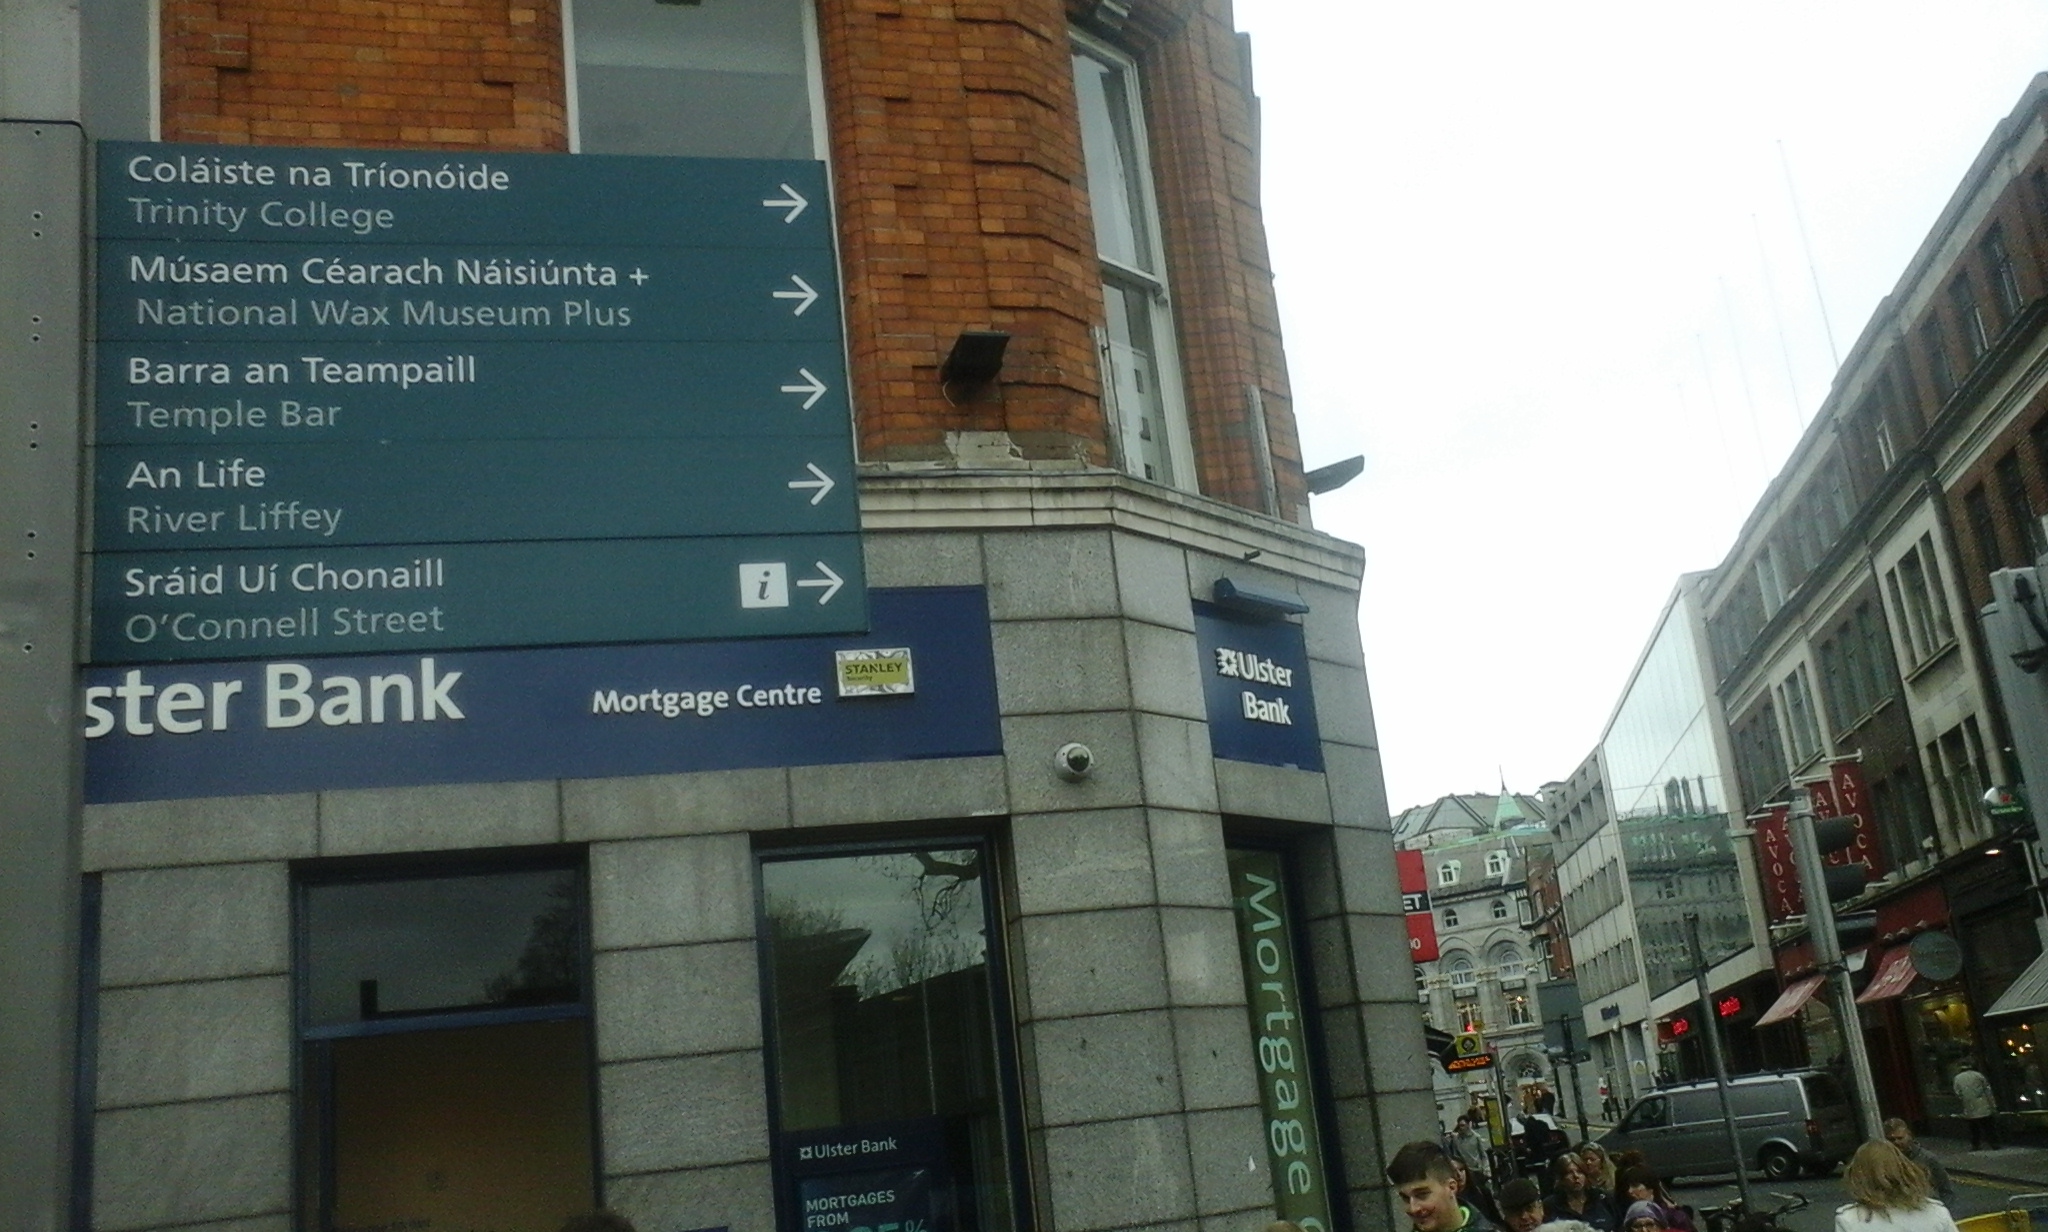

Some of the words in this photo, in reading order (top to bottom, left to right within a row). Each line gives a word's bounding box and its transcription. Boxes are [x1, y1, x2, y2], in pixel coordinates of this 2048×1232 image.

[129, 156, 275, 185] Coláiste
[290, 167, 330, 186] na
[343, 162, 509, 190] Tríonóide
[128, 198, 247, 232] Trinity
[261, 201, 394, 234] College
[131, 256, 287, 283] Músaem
[302, 258, 442, 284] Céarach
[458, 259, 616, 285] Náisiúnta
[138, 299, 296, 325] National
[311, 300, 390, 325] Wax
[404, 301, 550, 325] Museum
[564, 299, 631, 326] Plus
[130, 358, 229, 383] Barra
[245, 364, 288, 383] an
[302, 355, 474, 389] Teampaill
[127, 400, 266, 434] Temple
[282, 401, 341, 426] Bar
[127, 462, 180, 488] An
[198, 458, 265, 487] Life
[129, 505, 224, 533] River
[240, 501, 342, 536] Liffey
[126, 565, 222, 596] Sráid
[240, 564, 278, 592] Uí
[292, 558, 442, 591] Chonaill
[126, 607, 318, 642] O'Connell
[334, 607, 444, 635] Street
[845, 662, 903, 675] STANLEY
[1237, 652, 1292, 687] Ulster
[266, 658, 465, 727] Bank
[593, 689, 728, 717] Mortgage
[737, 684, 821, 706] Centre
[1242, 692, 1291, 724] Bank
[1765, 829, 1794, 915] AVOCA
[1246, 873, 1312, 1195] Mortgage
[815, 1143, 857, 1158] Ulster
[862, 1137, 897, 1153] Bank
[806, 1190, 895, 1212] MORTGAGES
[807, 1212, 848, 1228] FROM
